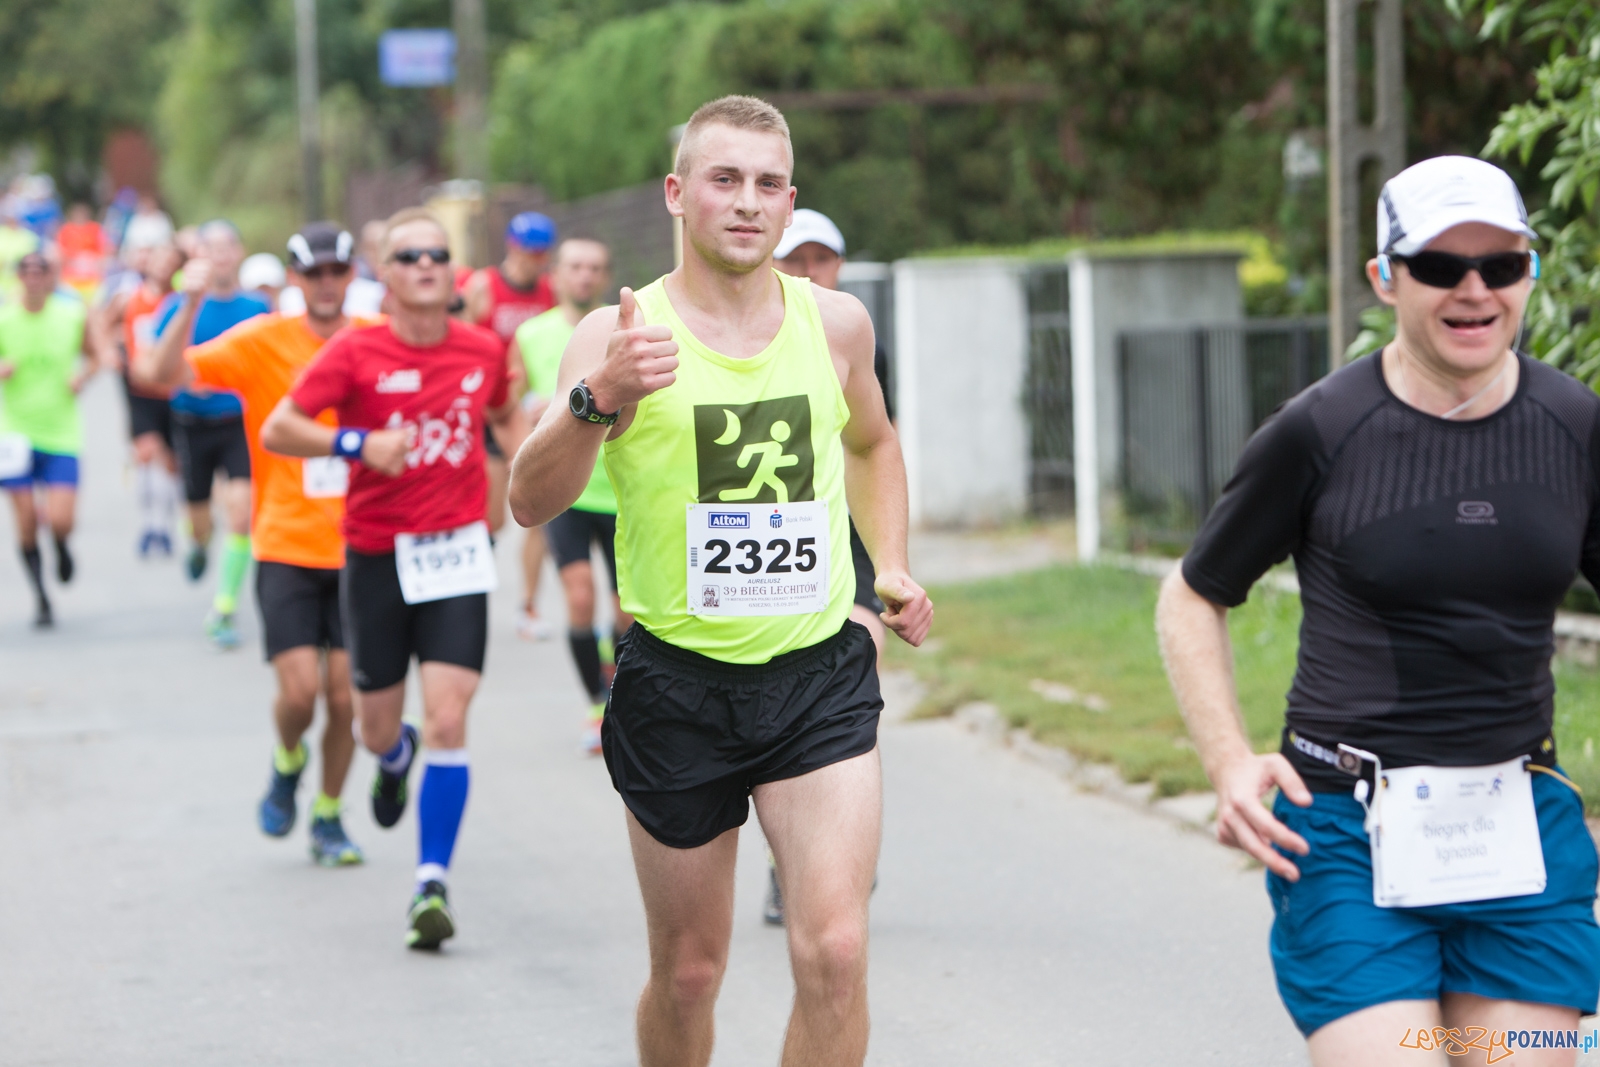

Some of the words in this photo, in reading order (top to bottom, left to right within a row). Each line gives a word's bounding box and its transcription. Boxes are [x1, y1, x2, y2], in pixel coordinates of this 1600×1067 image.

[412, 545, 476, 574] 1997
[704, 537, 817, 574] 2325
[723, 586, 737, 597] 39
[740, 586, 767, 596] BIEG
[770, 582, 819, 595] LECHITÓW
[1472, 815, 1496, 833] dla
